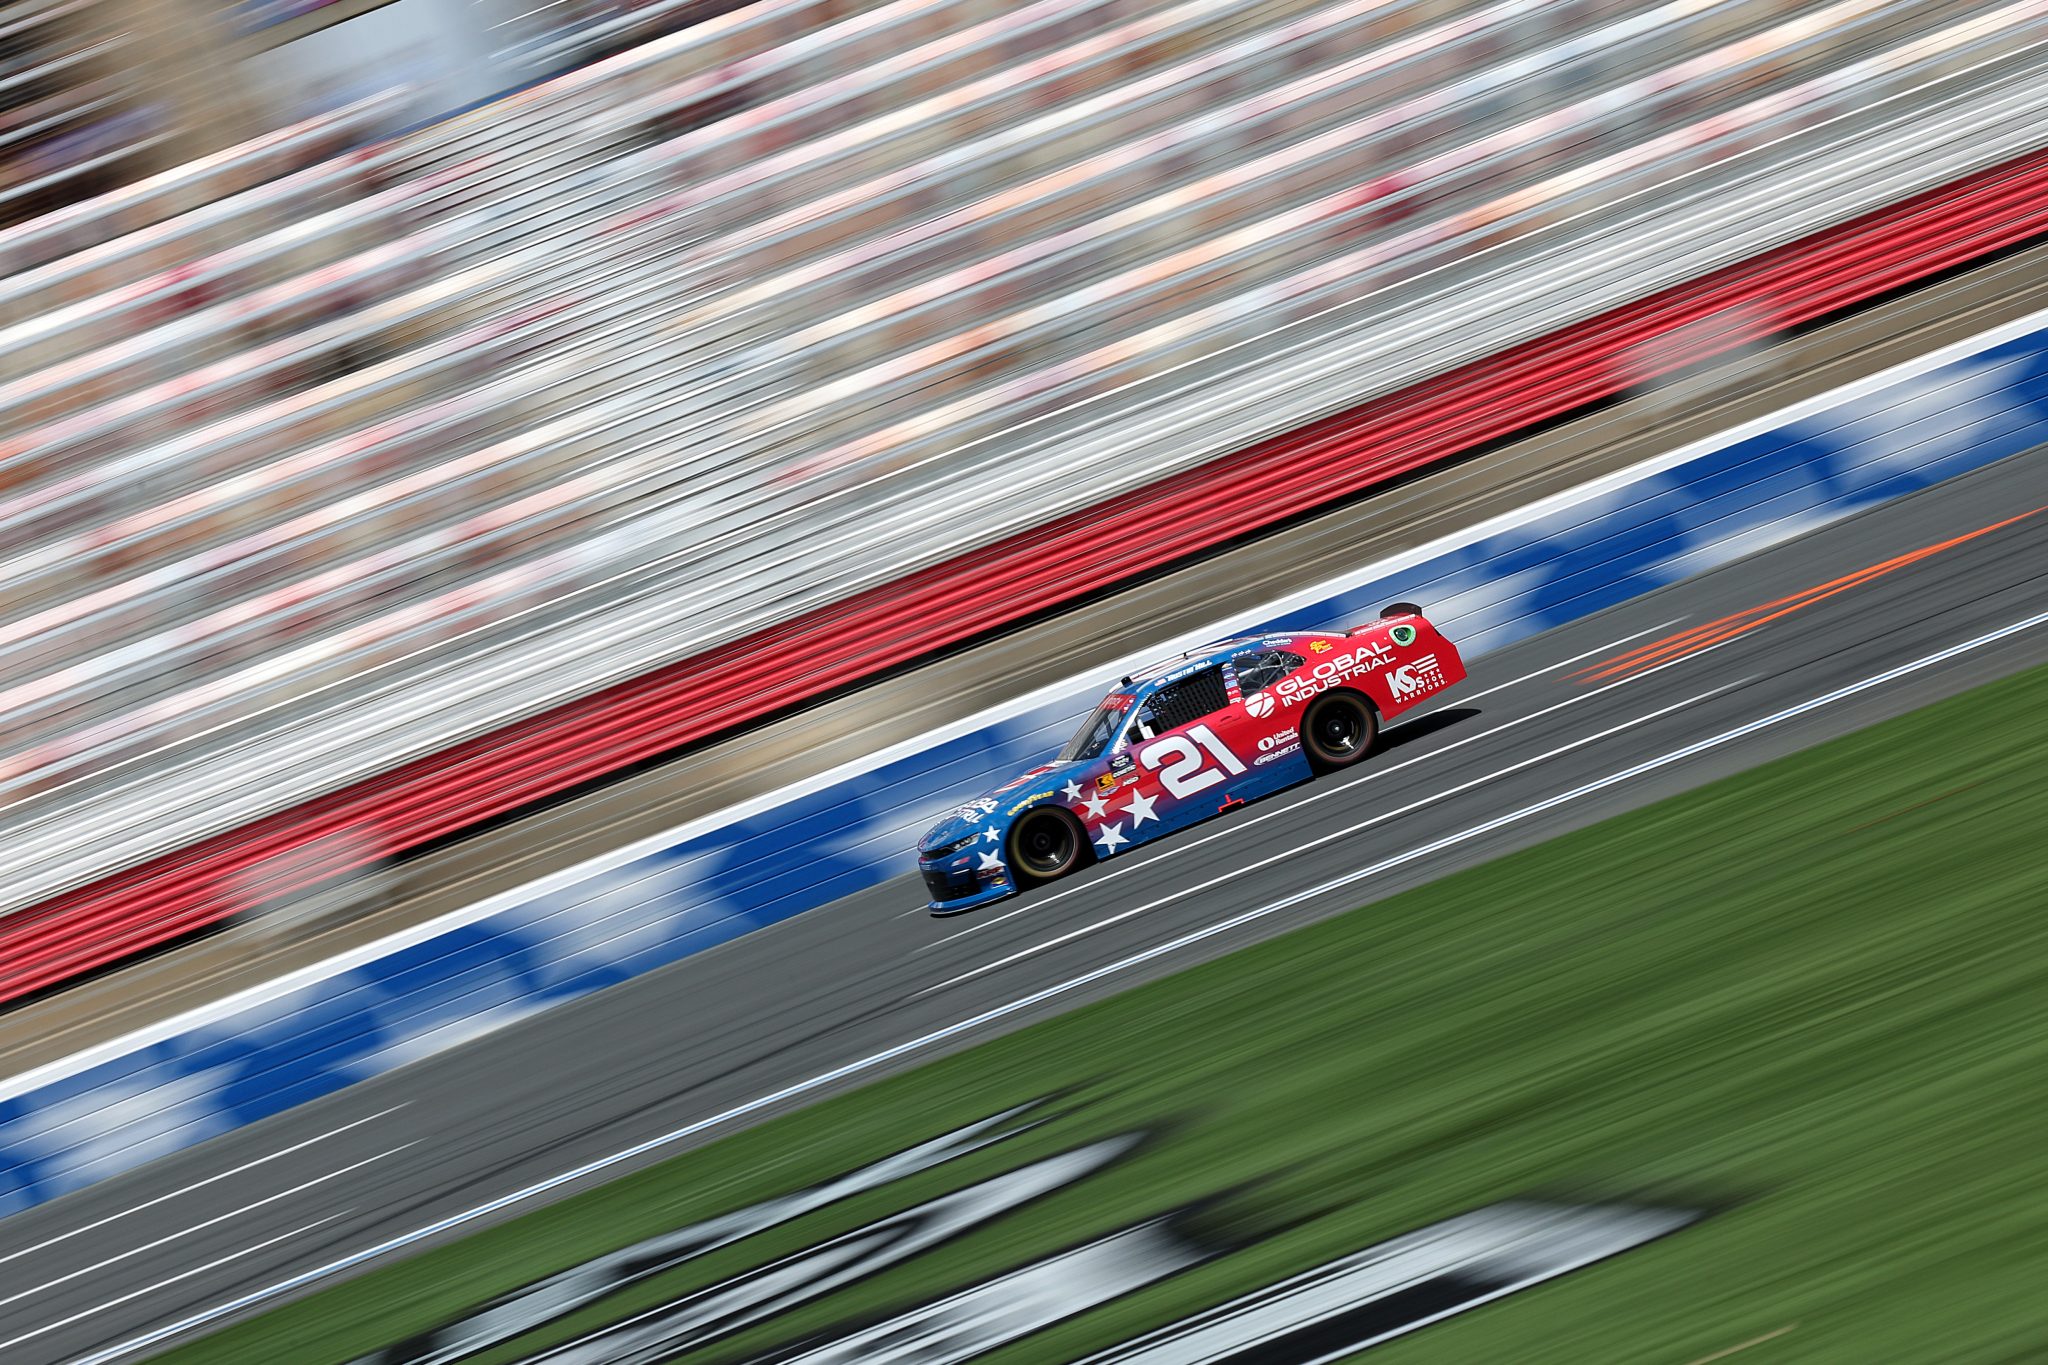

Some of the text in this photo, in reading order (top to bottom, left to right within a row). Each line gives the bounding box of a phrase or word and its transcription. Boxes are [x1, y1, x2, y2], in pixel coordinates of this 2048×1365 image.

[1275, 641, 1393, 696] GLOBAL
[1426, 673, 1444, 685] FOR
[1281, 653, 1397, 708] INDUSTRIAL
[1272, 726, 1295, 740] United
[1275, 732, 1299, 746] Rentals
[1140, 724, 1248, 800] 21
[1257, 742, 1301, 765] BENNETT
